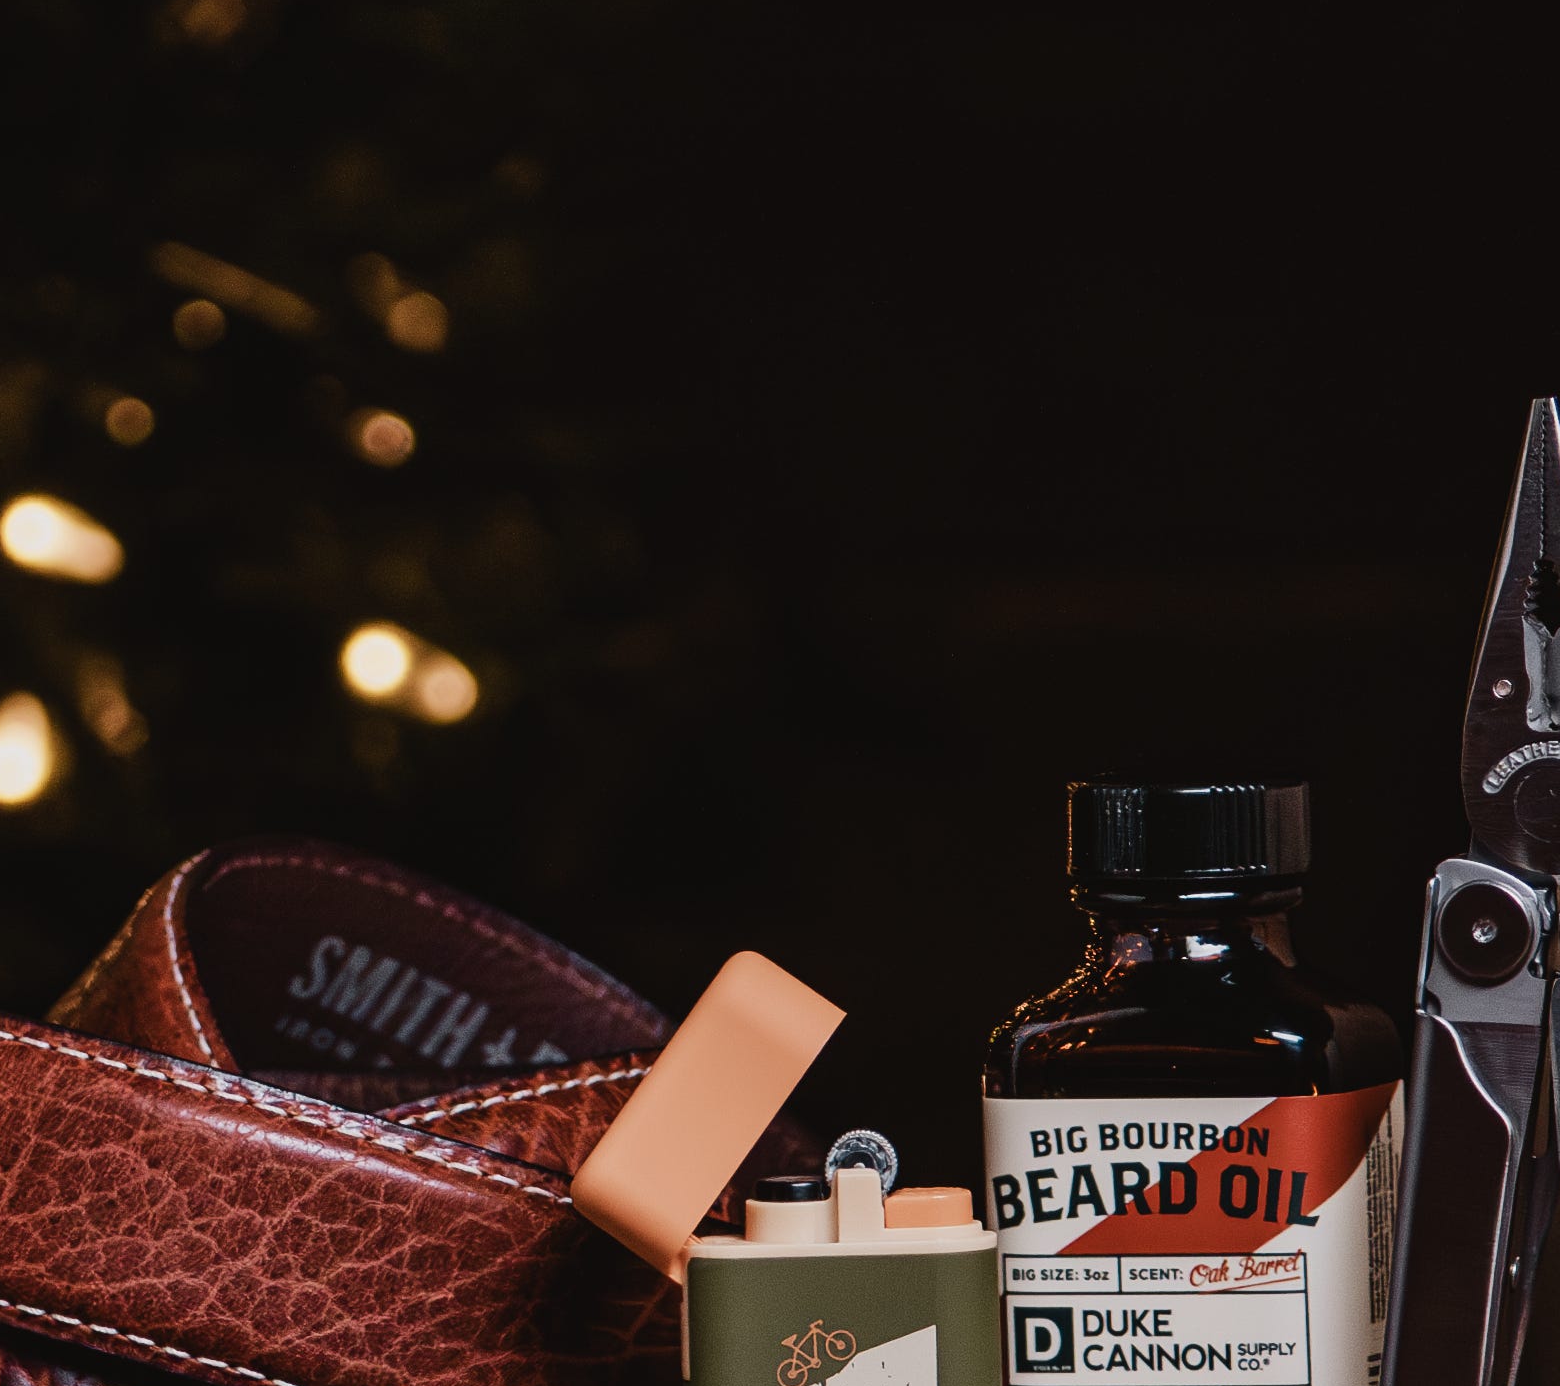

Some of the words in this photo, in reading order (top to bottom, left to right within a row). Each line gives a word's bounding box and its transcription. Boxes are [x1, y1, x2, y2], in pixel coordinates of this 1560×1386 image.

[288, 935, 491, 1068] SMITH
[1029, 1125, 1088, 1158] BIG
[1098, 1122, 1270, 1157] BOURBON
[992, 1160, 1198, 1231] BEARD
[1218, 1164, 1320, 1227] OIL
[1011, 1268, 1036, 1281] BIG
[1040, 1268, 1079, 1281] SIZE:
[1129, 1268, 1184, 1281] SCENT:
[1189, 1259, 1230, 1287] Oak
[1233, 1248, 1304, 1282] Barrel
[1025, 1317, 1062, 1362] D
[1082, 1309, 1173, 1338] DUKE
[1082, 1343, 1233, 1372] CANNON
[1237, 1342, 1297, 1356] SUPPLY
